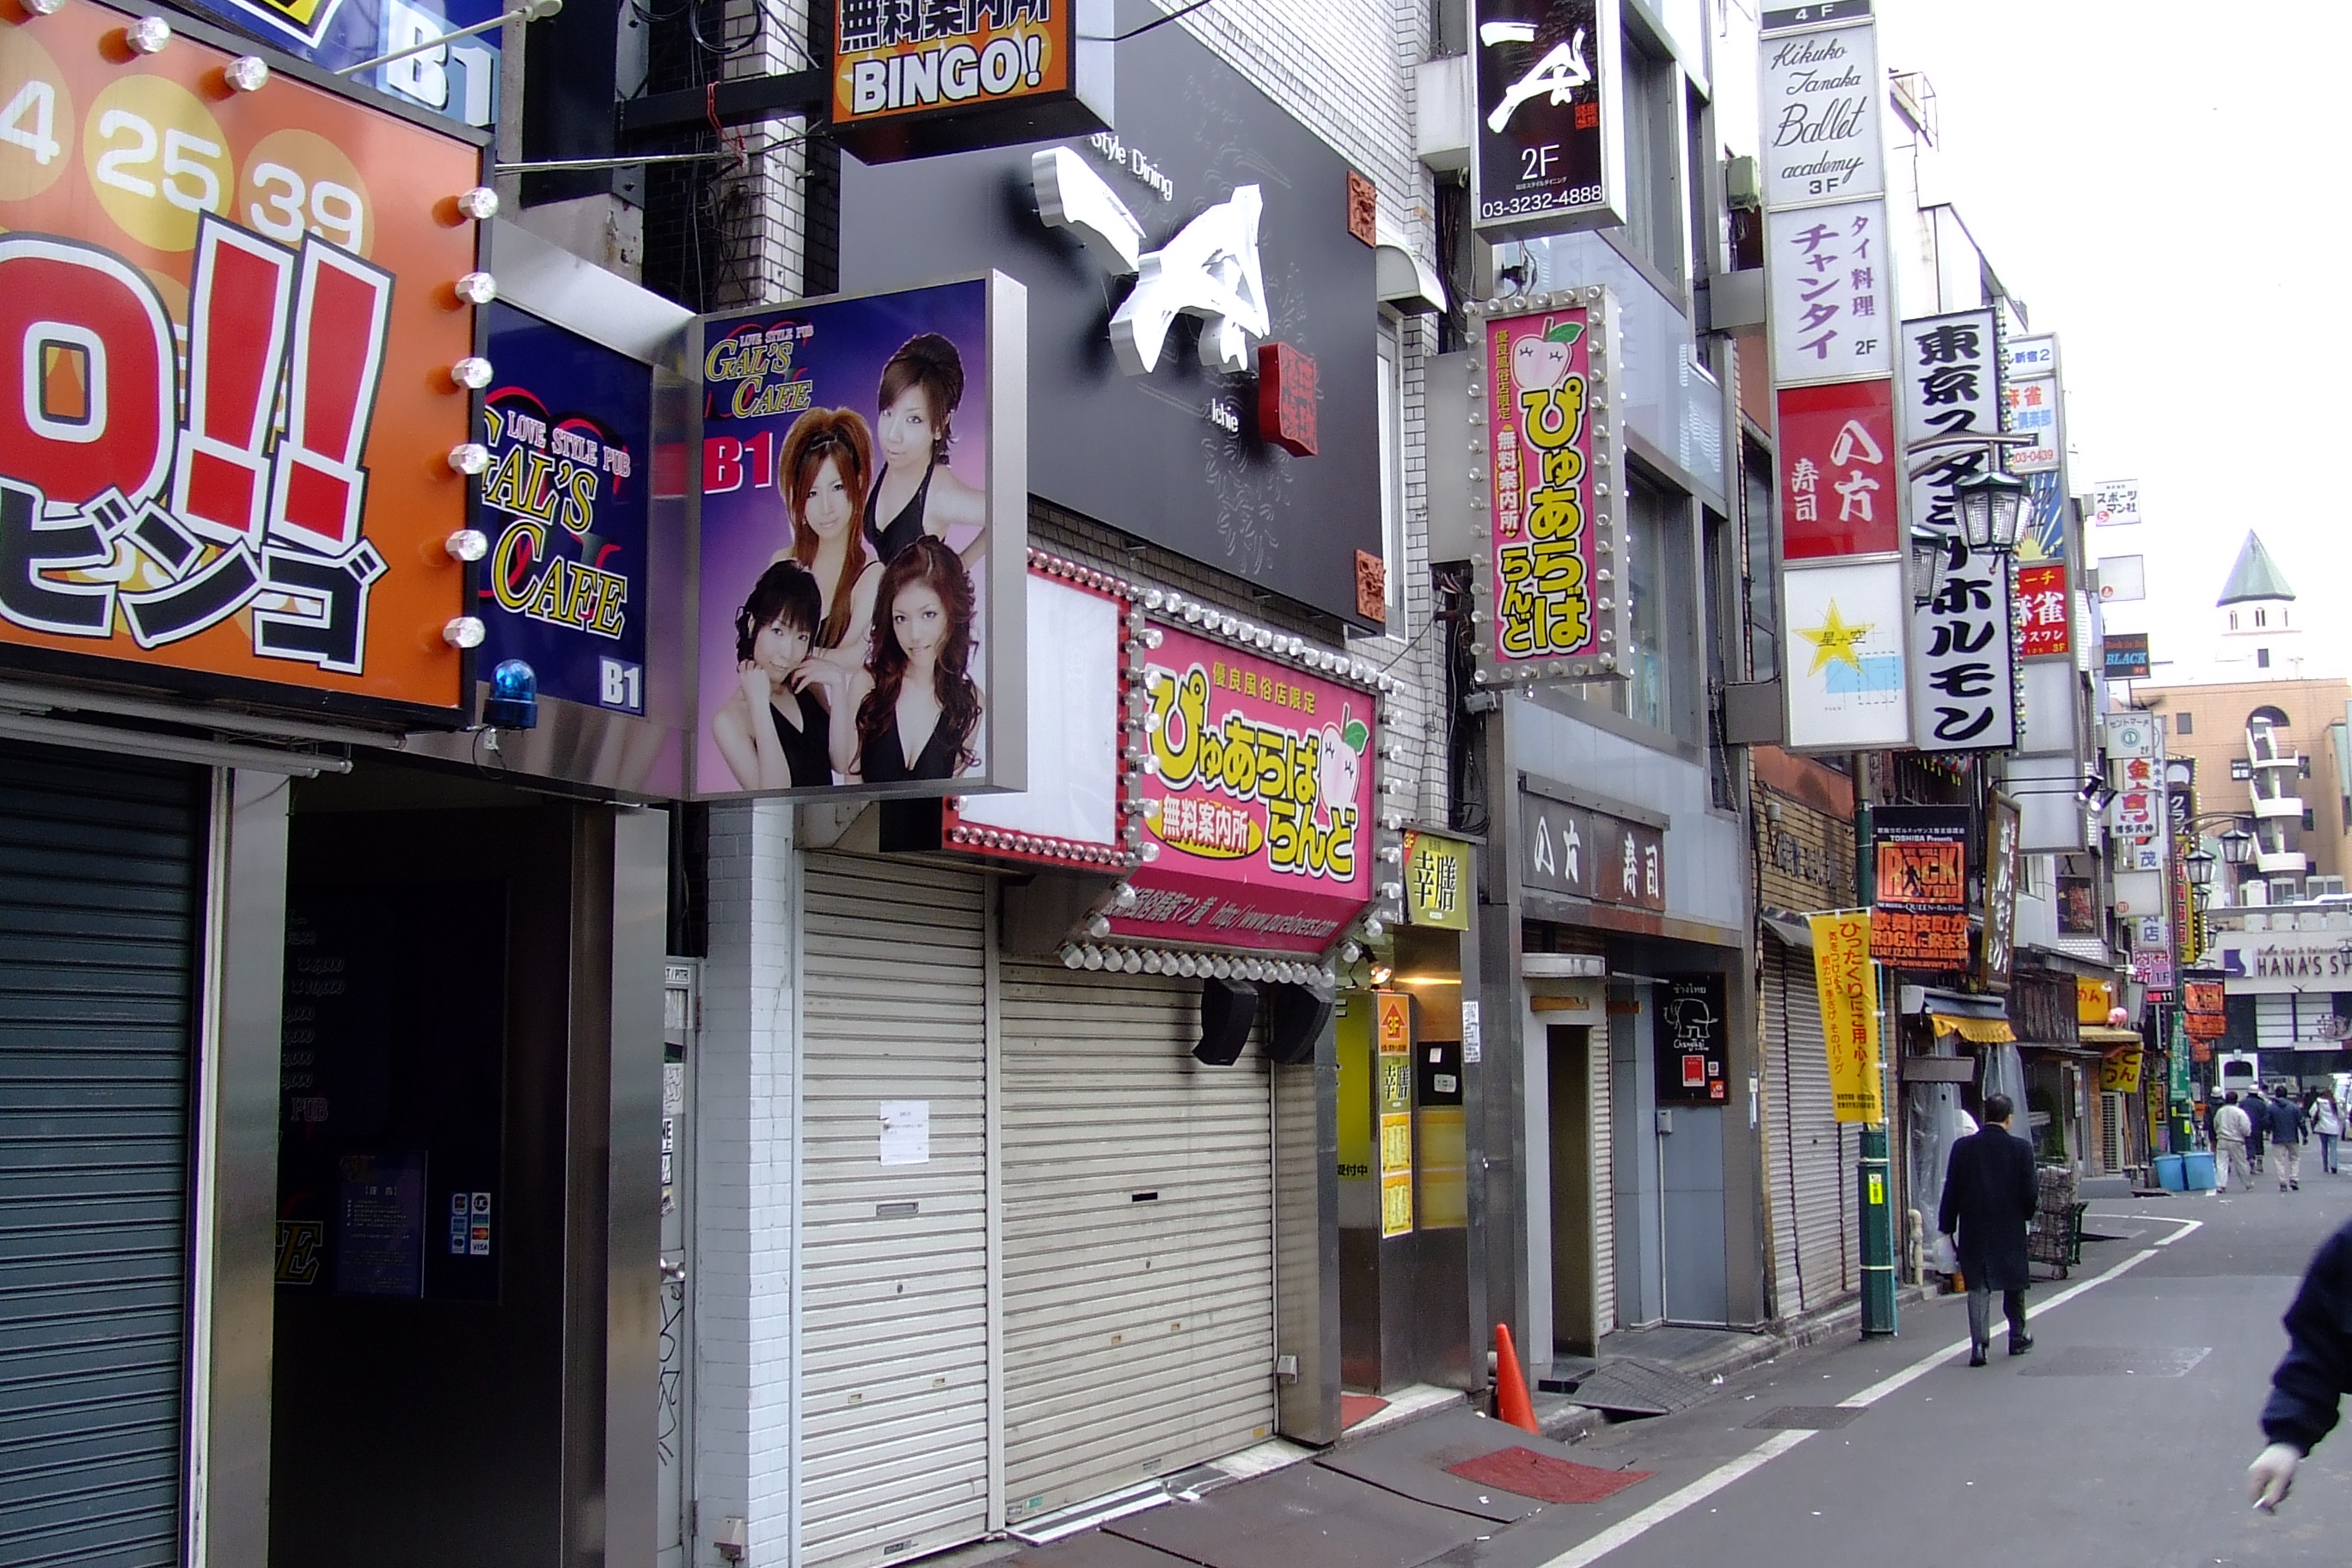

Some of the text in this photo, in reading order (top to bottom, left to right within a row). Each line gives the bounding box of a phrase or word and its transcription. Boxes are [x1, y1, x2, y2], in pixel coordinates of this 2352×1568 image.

[386, 26, 497, 127] B1
[851, 34, 1042, 116] BINGO!
[1771, 38, 1847, 70] Kikuko
[1785, 64, 1862, 95] Tanaka
[1772, 96, 1868, 148] Ballet
[96, 109, 222, 213] 25
[1091, 132, 1173, 201] Style Dining
[1521, 144, 1560, 181] 2F
[1781, 150, 1865, 184] academy
[249, 162, 364, 256] 39
[1482, 184, 1602, 218] 03-3232-4888
[1809, 177, 1840, 194] 3F
[1850, 215, 1876, 318] タイ料理
[1791, 224, 1841, 360] チャンタイ
[739, 325, 815, 347] LOVE STYLE PUB
[1854, 340, 1878, 356] 2F
[705, 339, 793, 382] GAL'S
[732, 376, 813, 419] CAFE
[1210, 399, 1240, 433] Ichie
[506, 410, 632, 478] LOVE STYLE PUB
[703, 430, 774, 495] B1
[1518, 376, 1589, 652] ぴゅあらば
[1791, 457, 1819, 524] 寿司
[2097, 490, 2138, 504] スポーツ
[493, 516, 629, 640] CAFE
[2105, 652, 2147, 665] BLACK
[602, 658, 641, 709] B1
[1212, 661, 1317, 716] 優良風俗店限定
[1146, 661, 1322, 812] ぴゅあらば
[1159, 793, 1252, 855] 無料案内所
[1267, 796, 1357, 883] らんど
[1906, 903, 1934, 914] QUEEN
[1673, 983, 1706, 995] ช้างไทย
[2257, 956, 2322, 977] HANA'S
[1387, 1015, 1400, 1035] 3F
[291, 1096, 329, 1122] PUB
